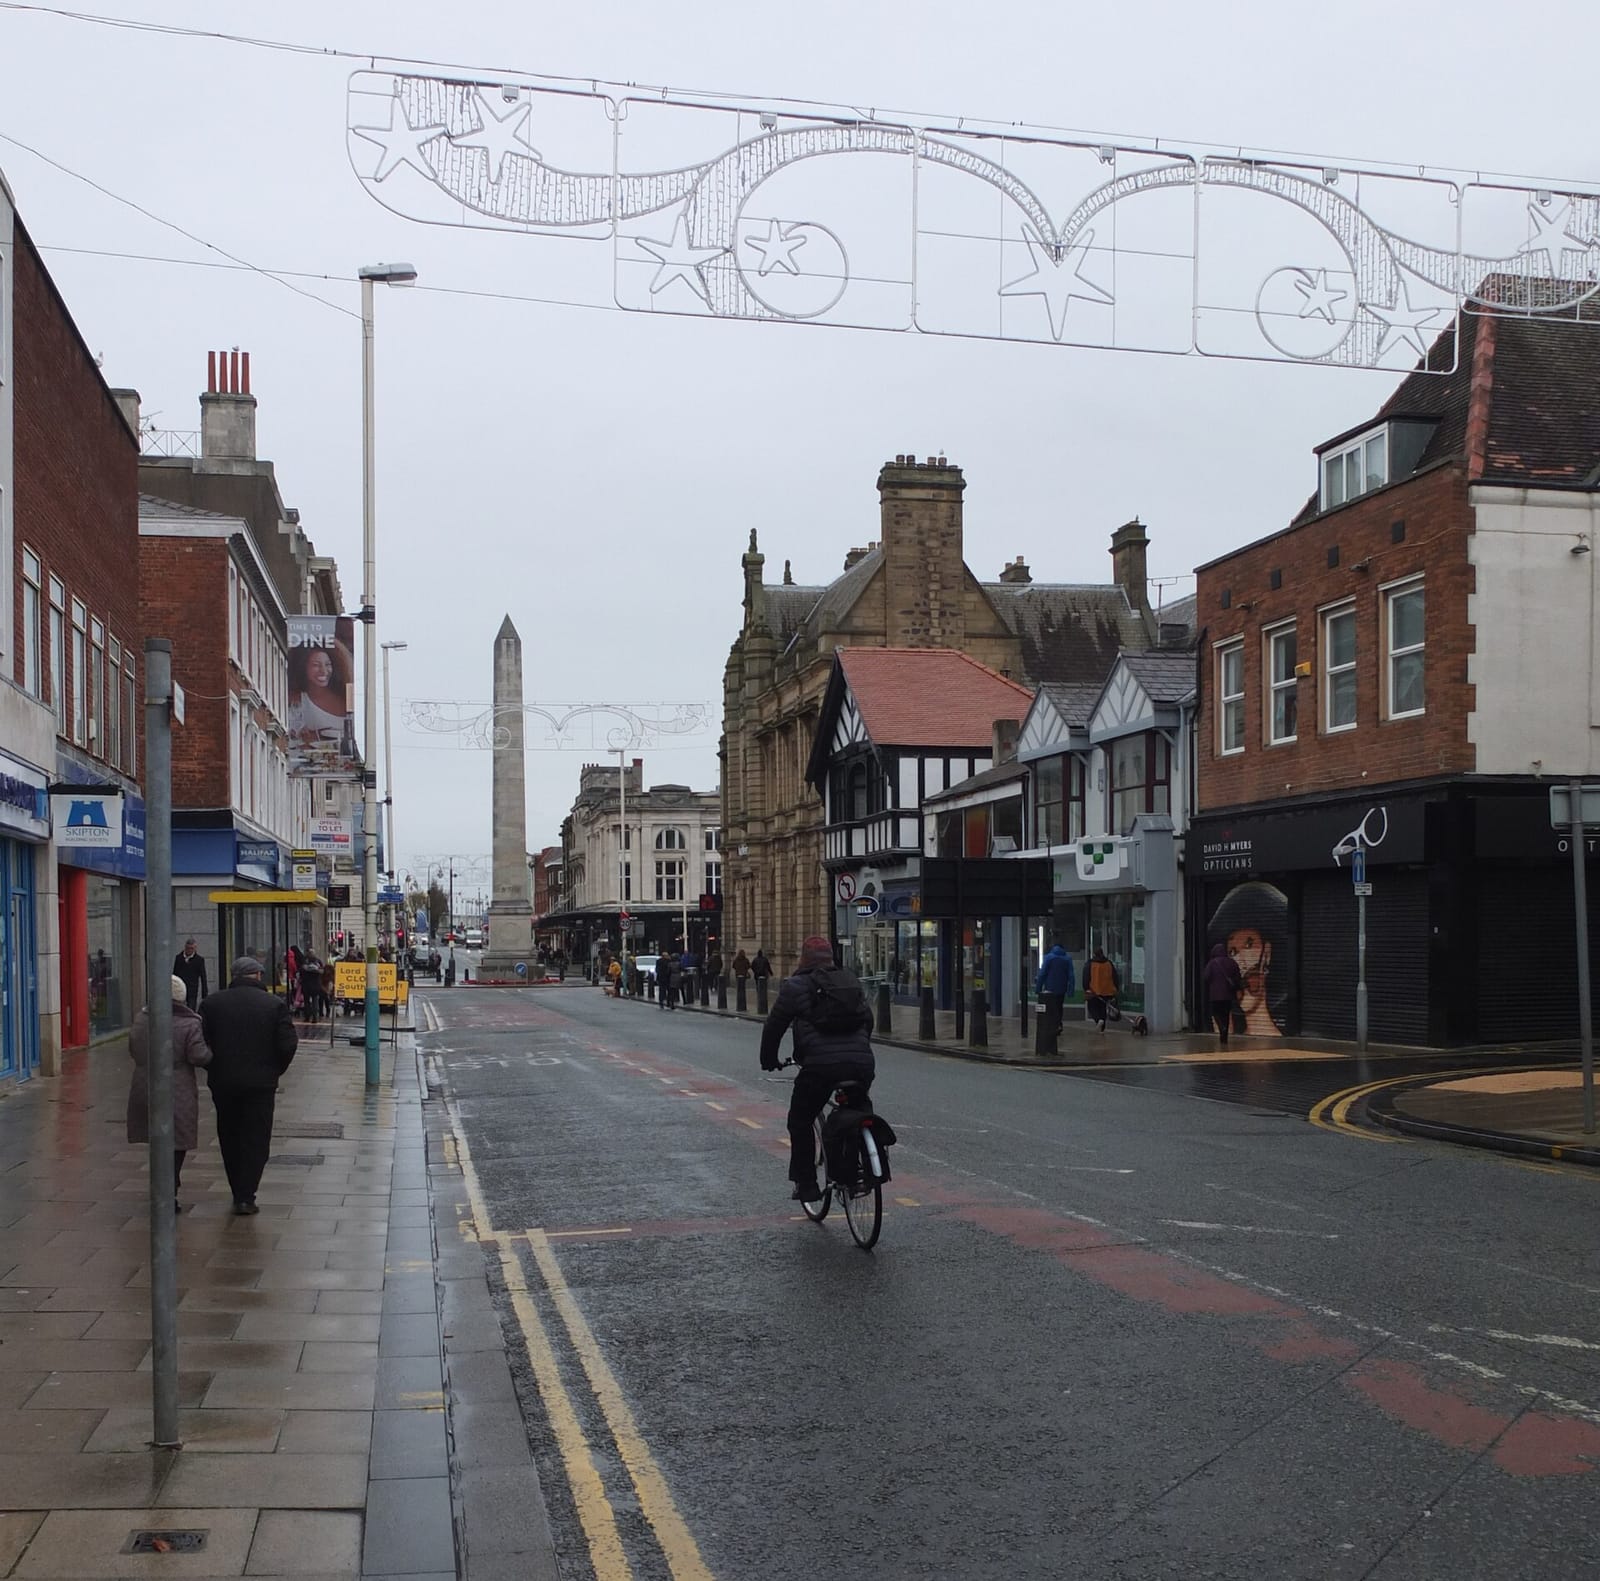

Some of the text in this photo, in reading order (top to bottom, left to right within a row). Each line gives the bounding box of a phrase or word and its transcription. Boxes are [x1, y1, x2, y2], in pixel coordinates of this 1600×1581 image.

[289, 623, 308, 631] TIME
[287, 633, 336, 648] DINE
[65, 828, 110, 836] SKIPTON
[1203, 843, 1222, 853] DAVID
[1230, 840, 1252, 851] MYERS
[1203, 857, 1252, 870] OPTICIANS
[346, 975, 387, 984] CLOD
[338, 982, 395, 992] Southund
